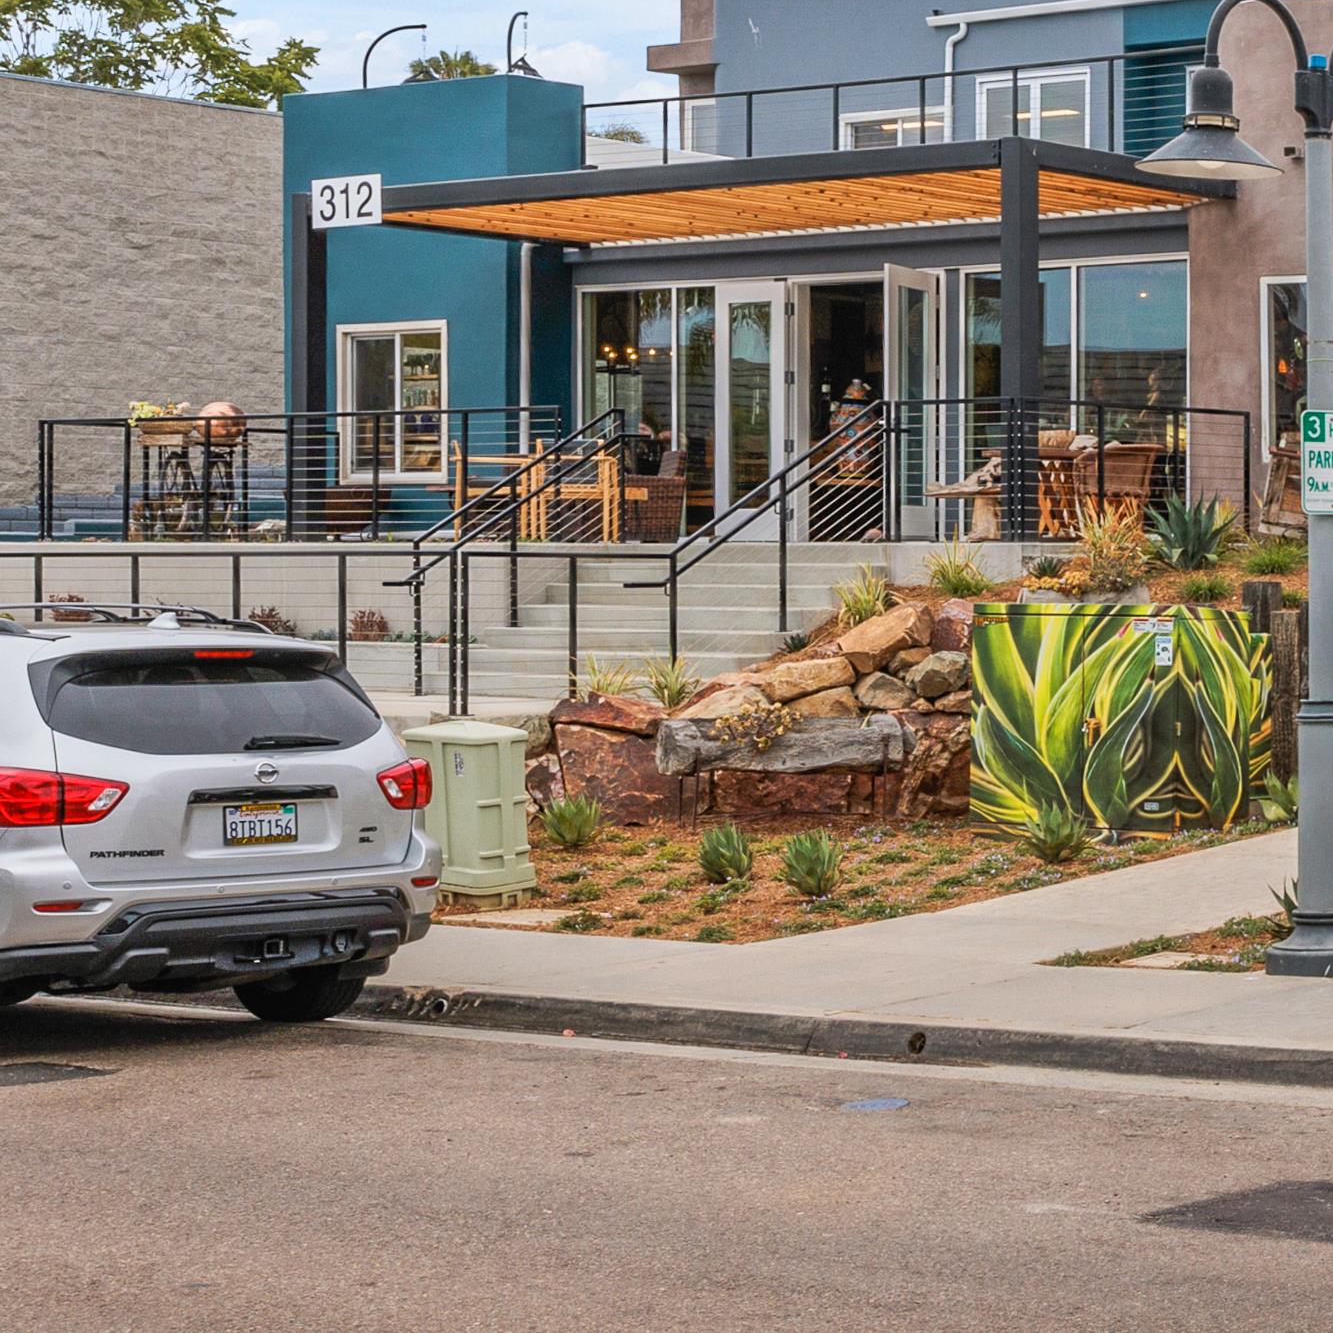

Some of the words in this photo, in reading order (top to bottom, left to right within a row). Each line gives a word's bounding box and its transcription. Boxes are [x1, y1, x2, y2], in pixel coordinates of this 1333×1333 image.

[319, 180, 374, 222] 312
[1307, 415, 1321, 439] 3
[229, 818, 293, 839] 8TBT156
[89, 849, 165, 859] PATHFINDER
